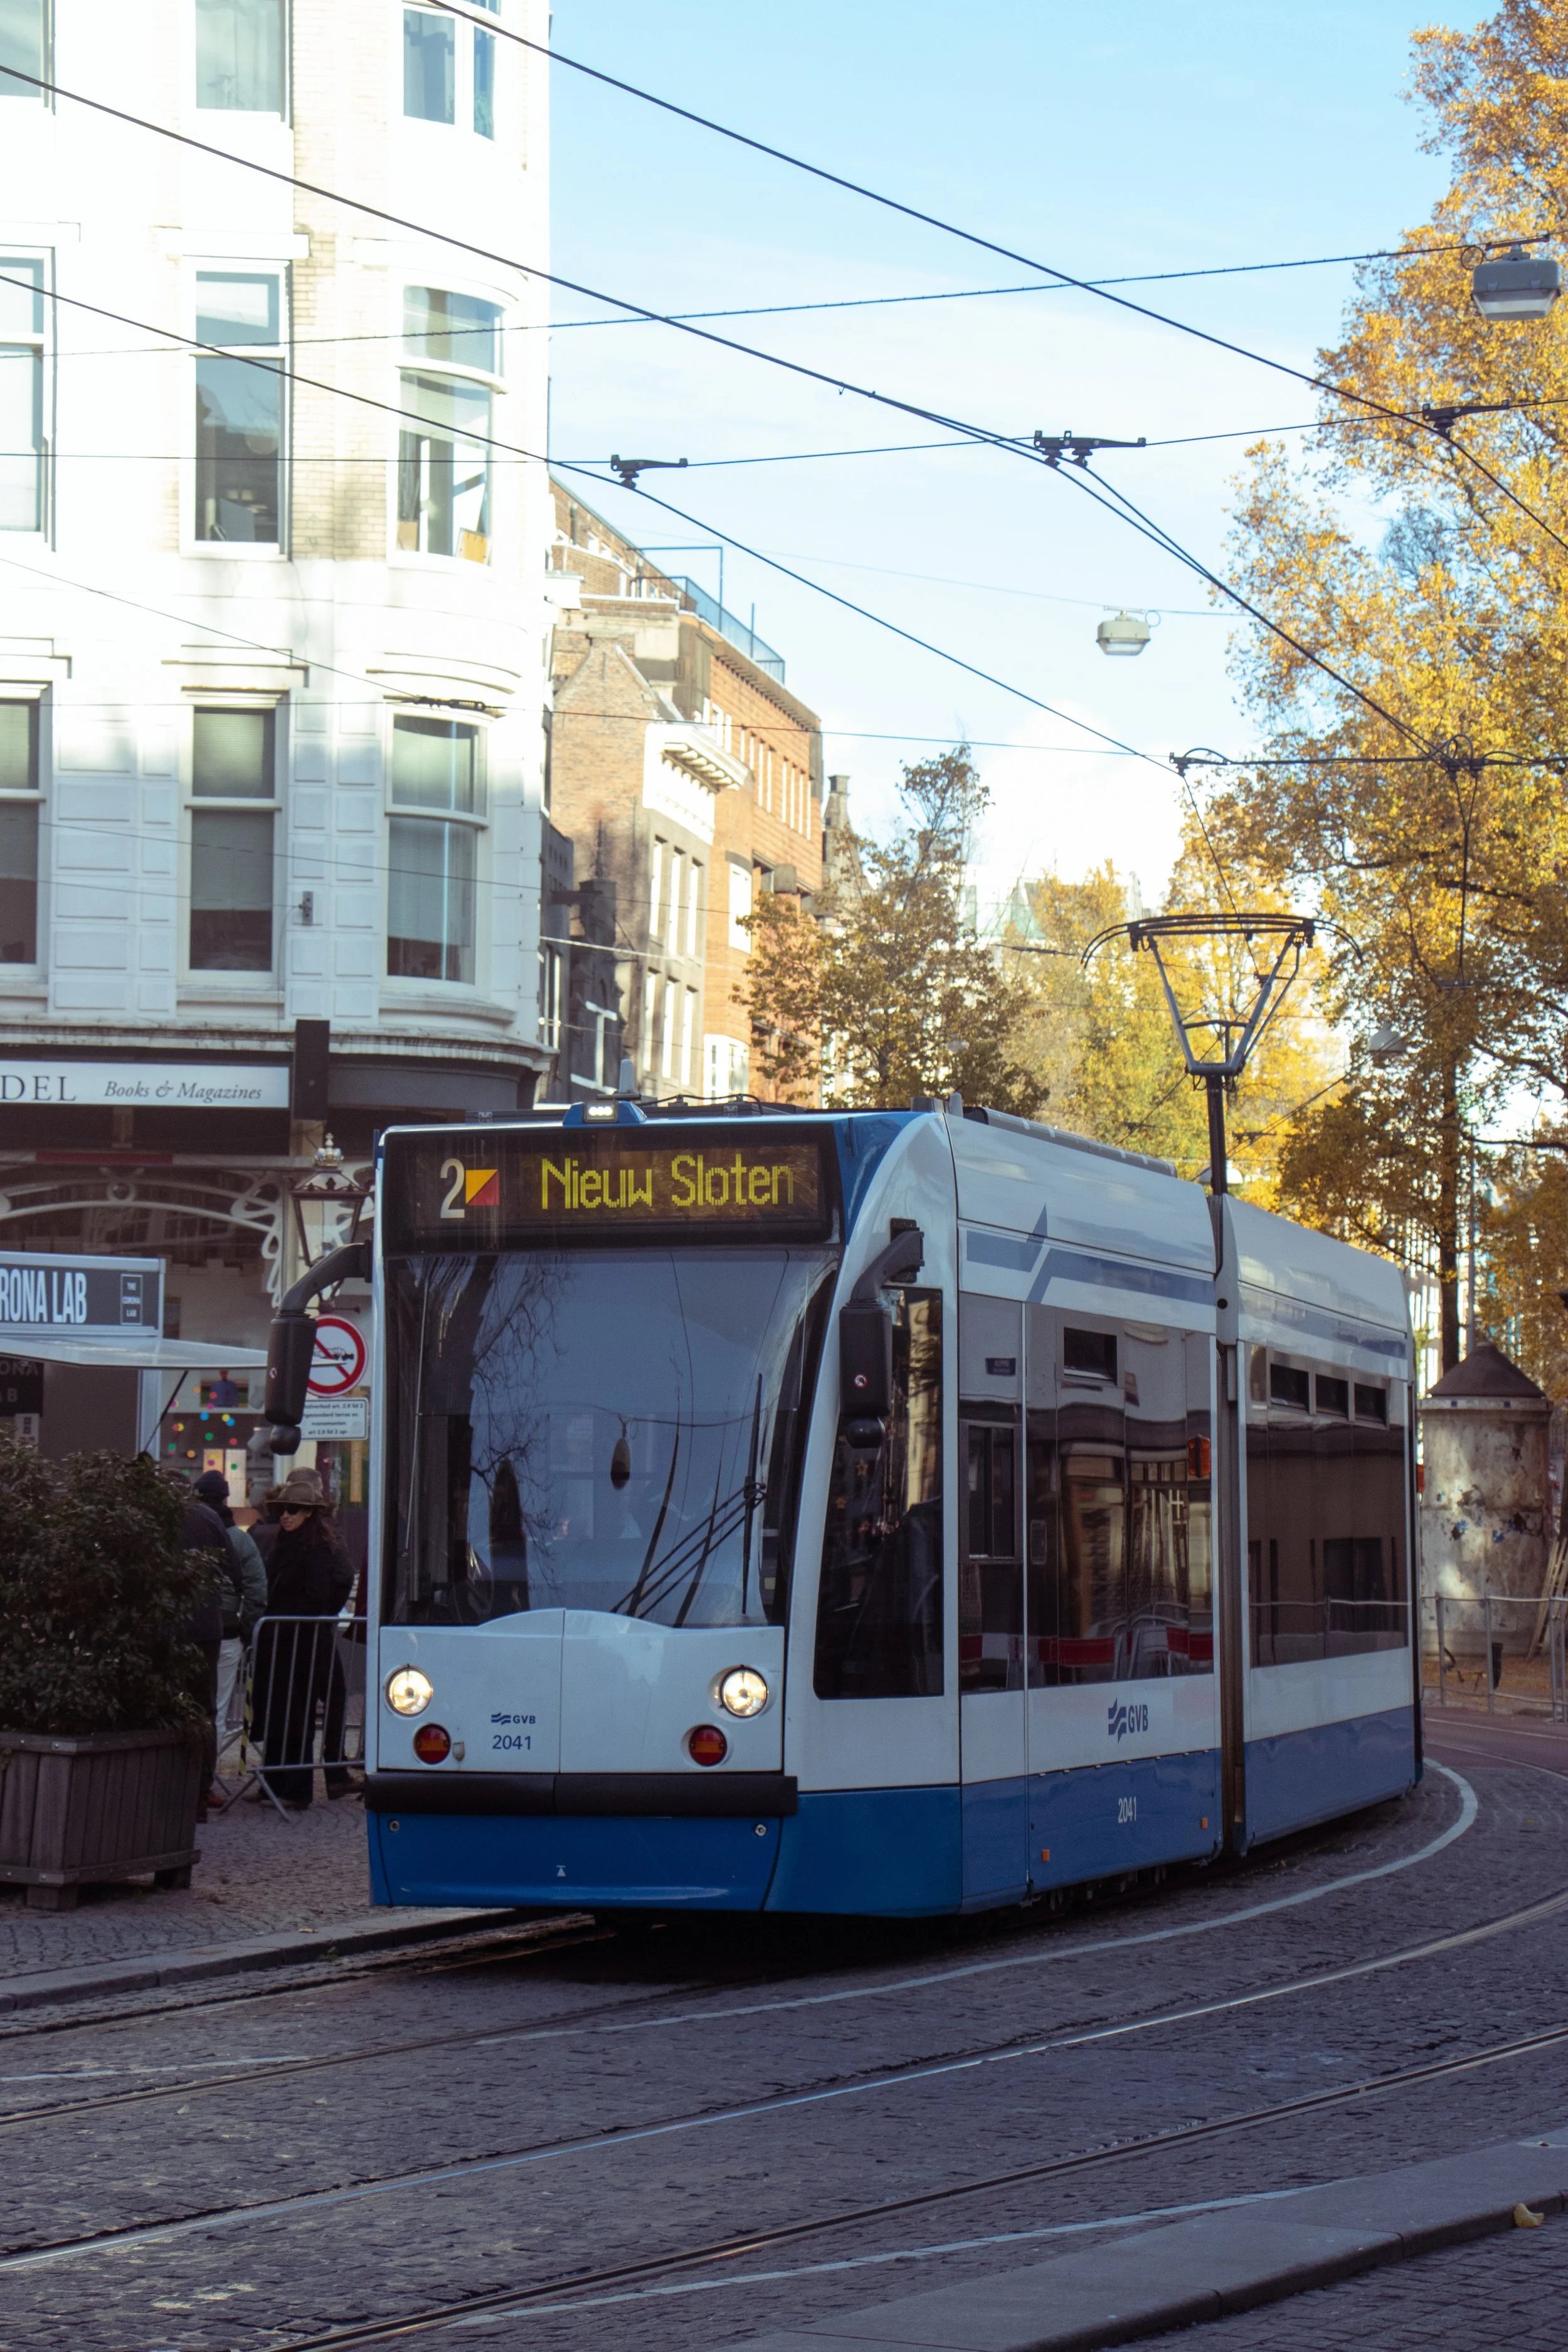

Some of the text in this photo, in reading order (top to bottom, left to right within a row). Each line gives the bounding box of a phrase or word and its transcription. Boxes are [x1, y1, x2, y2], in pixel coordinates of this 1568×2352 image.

[1, 1074, 262, 1104] DEL Books & Magazines
[440, 1158, 465, 1219] 2
[541, 1153, 794, 1210] Nieuw Sloten
[52, 1271, 88, 1324] LAB
[512, 1715, 536, 1724] GVB
[1128, 1704, 1149, 1734] GVB
[492, 1735, 531, 1751] 2041
[1118, 1796, 1137, 1824] 2041
